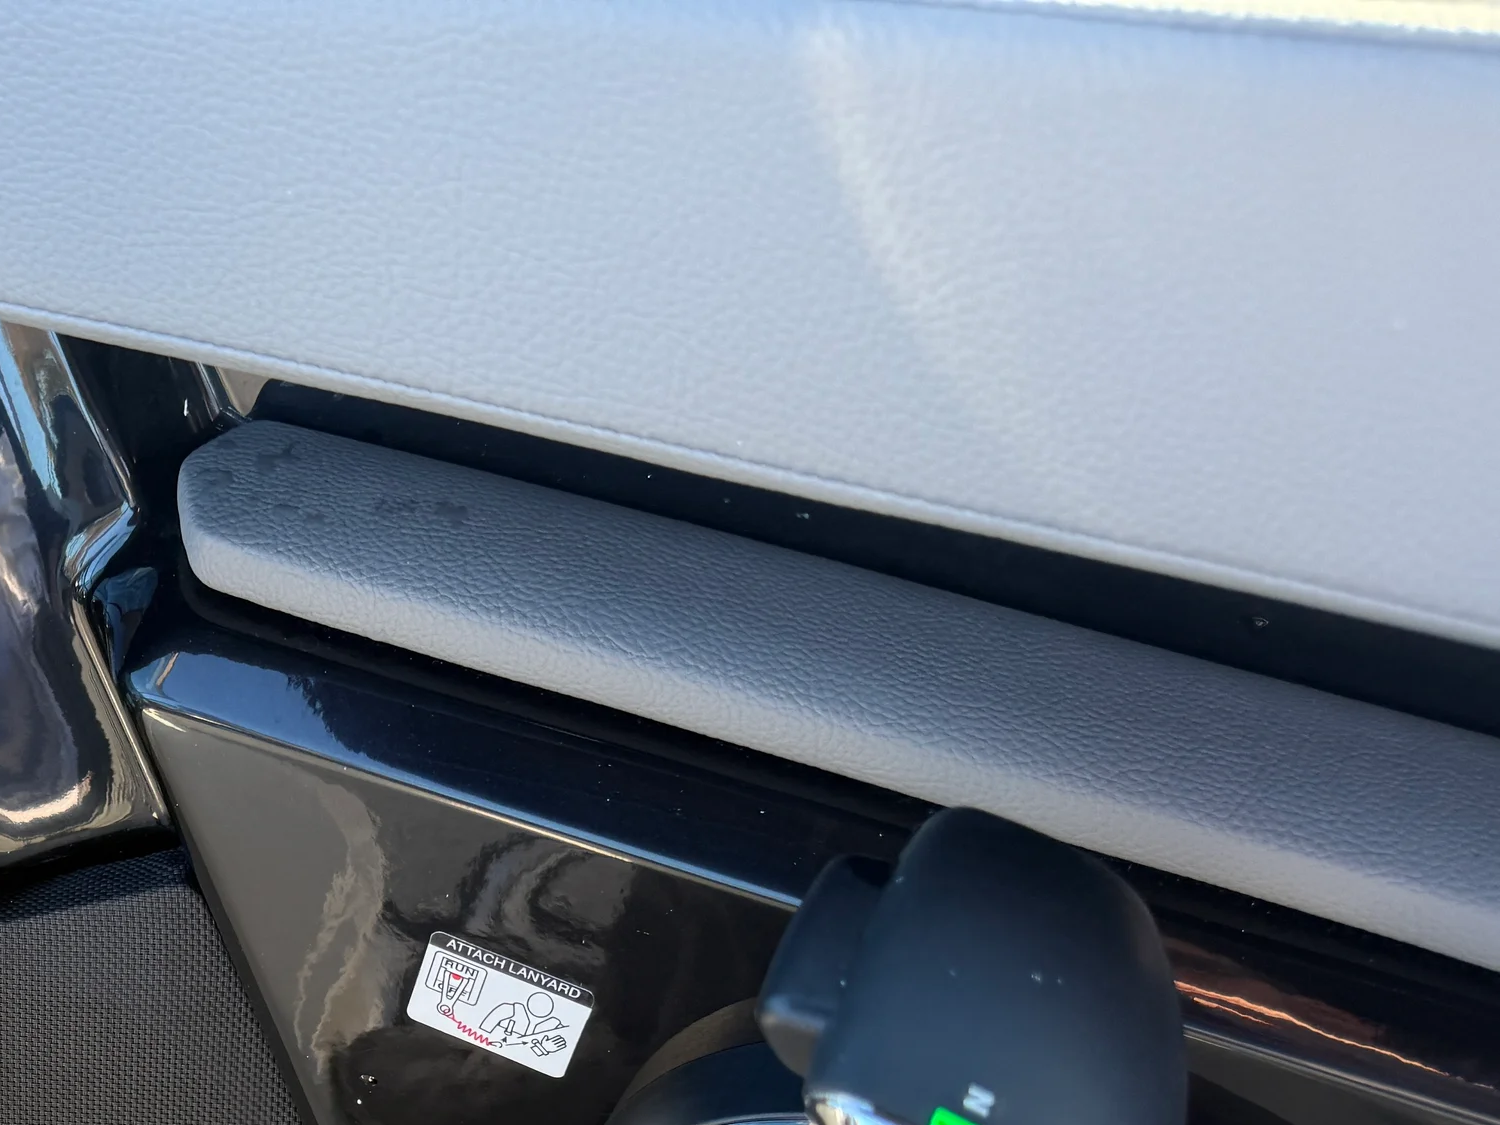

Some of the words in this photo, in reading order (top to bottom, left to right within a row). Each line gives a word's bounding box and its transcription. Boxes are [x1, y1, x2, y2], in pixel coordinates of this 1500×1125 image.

[444, 959, 476, 978] RUN
[446, 939, 506, 970] ATTACH
[508, 962, 582, 999] LANYARD
[962, 1081, 997, 1119] N
